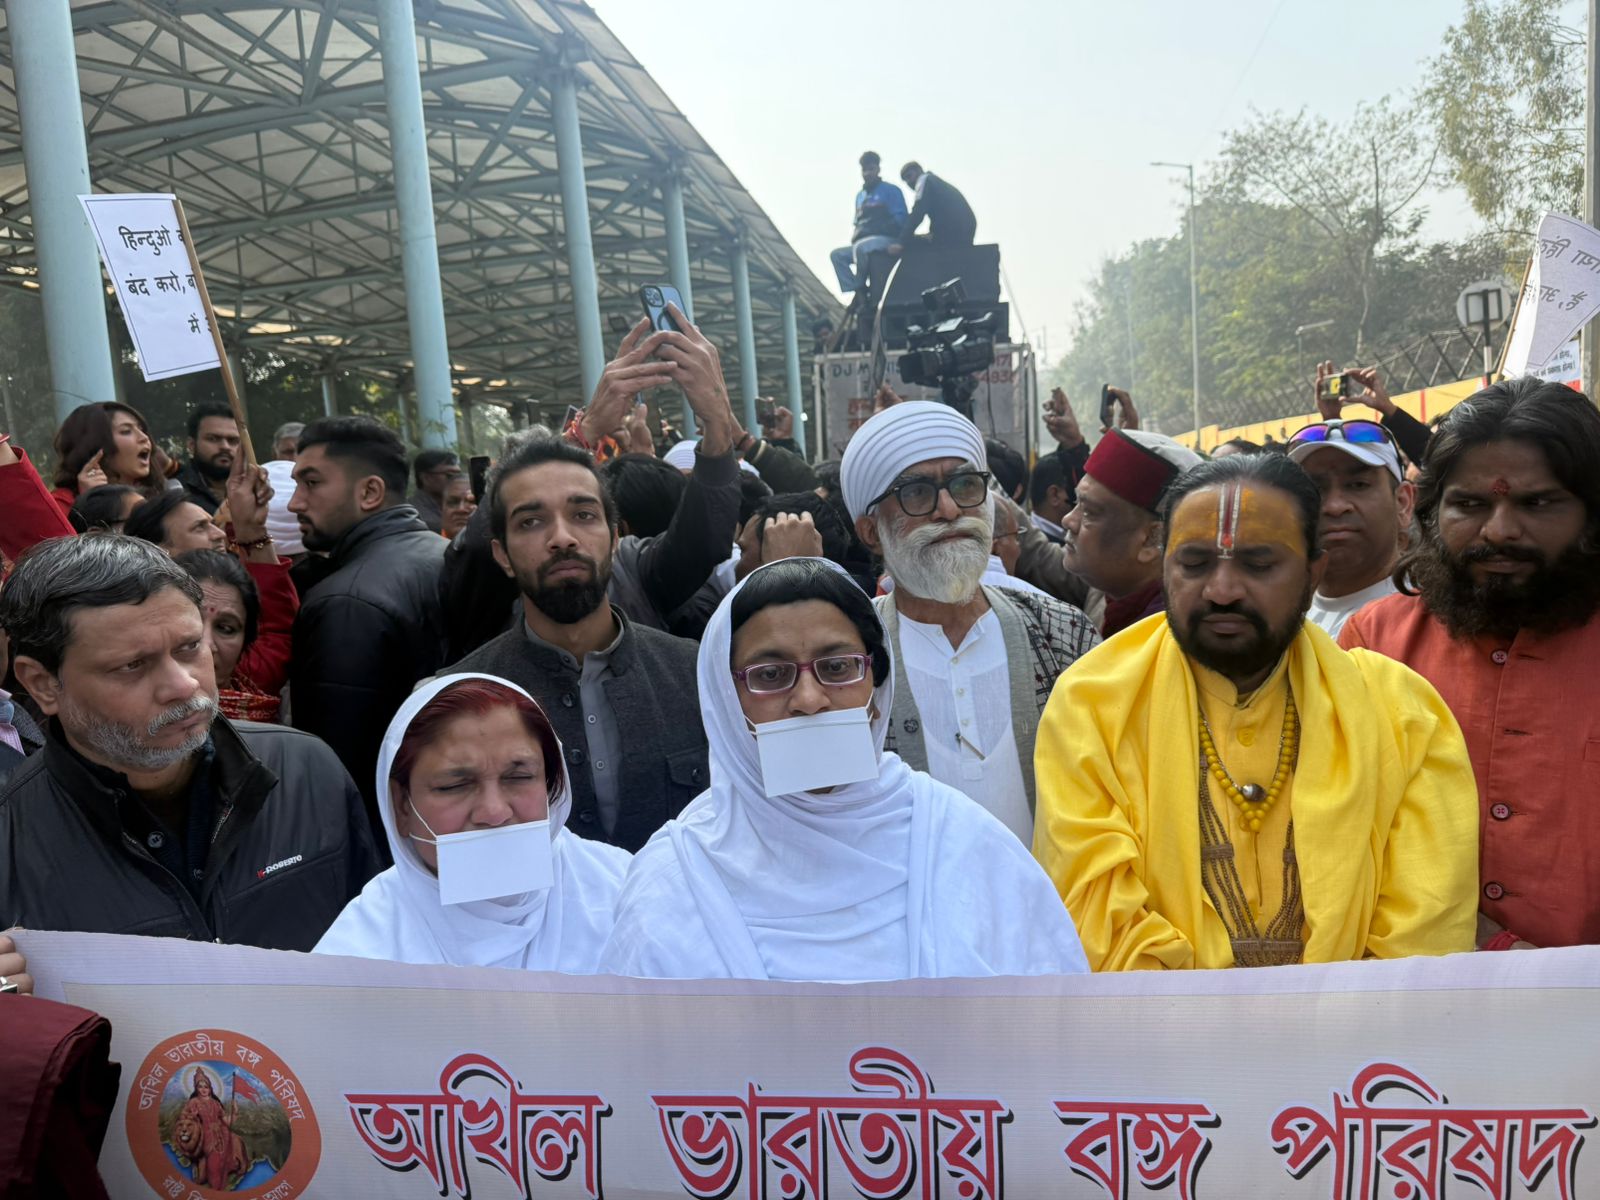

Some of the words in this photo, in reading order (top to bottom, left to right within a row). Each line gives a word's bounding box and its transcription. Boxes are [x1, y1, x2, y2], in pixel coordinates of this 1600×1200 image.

[125, 272, 151, 296] बंद
[154, 270, 186, 295] करो,
[188, 313, 201, 334] में
[832, 363, 852, 377] DJ
[139, 1062, 168, 1110] অখিল
[164, 1033, 225, 1063] ভারতীয়
[236, 1044, 263, 1069] বঙ্গ
[270, 1069, 306, 1122] পরিষদ
[343, 1052, 613, 1200] অখিল
[650, 1046, 1014, 1200] ভারতীয়
[1053, 1101, 1222, 1200] বঙ্গ
[1270, 1062, 1599, 1200] পরিষদ
